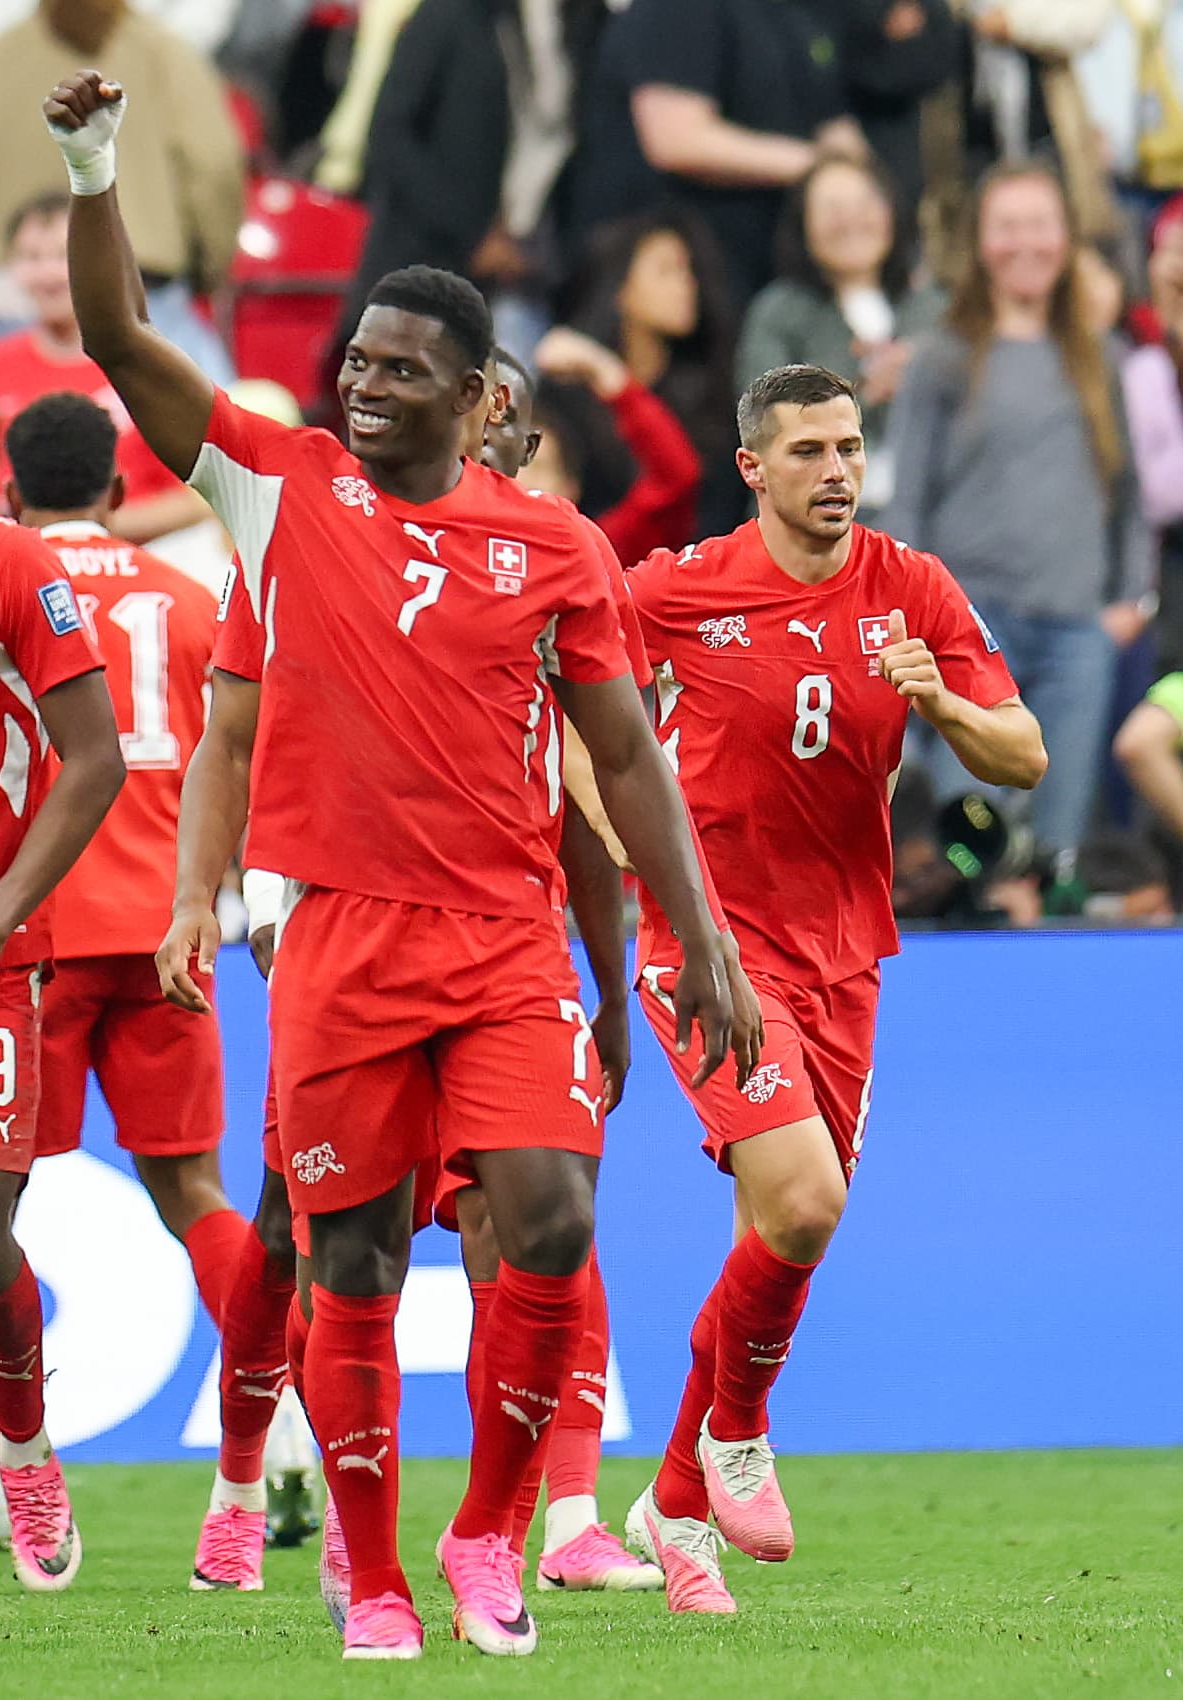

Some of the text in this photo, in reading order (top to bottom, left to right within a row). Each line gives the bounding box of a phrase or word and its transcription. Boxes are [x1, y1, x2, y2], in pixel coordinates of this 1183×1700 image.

[398, 560, 448, 636] 7
[76, 592, 181, 770] 1
[791, 675, 832, 760] 8
[558, 998, 594, 1081] 7
